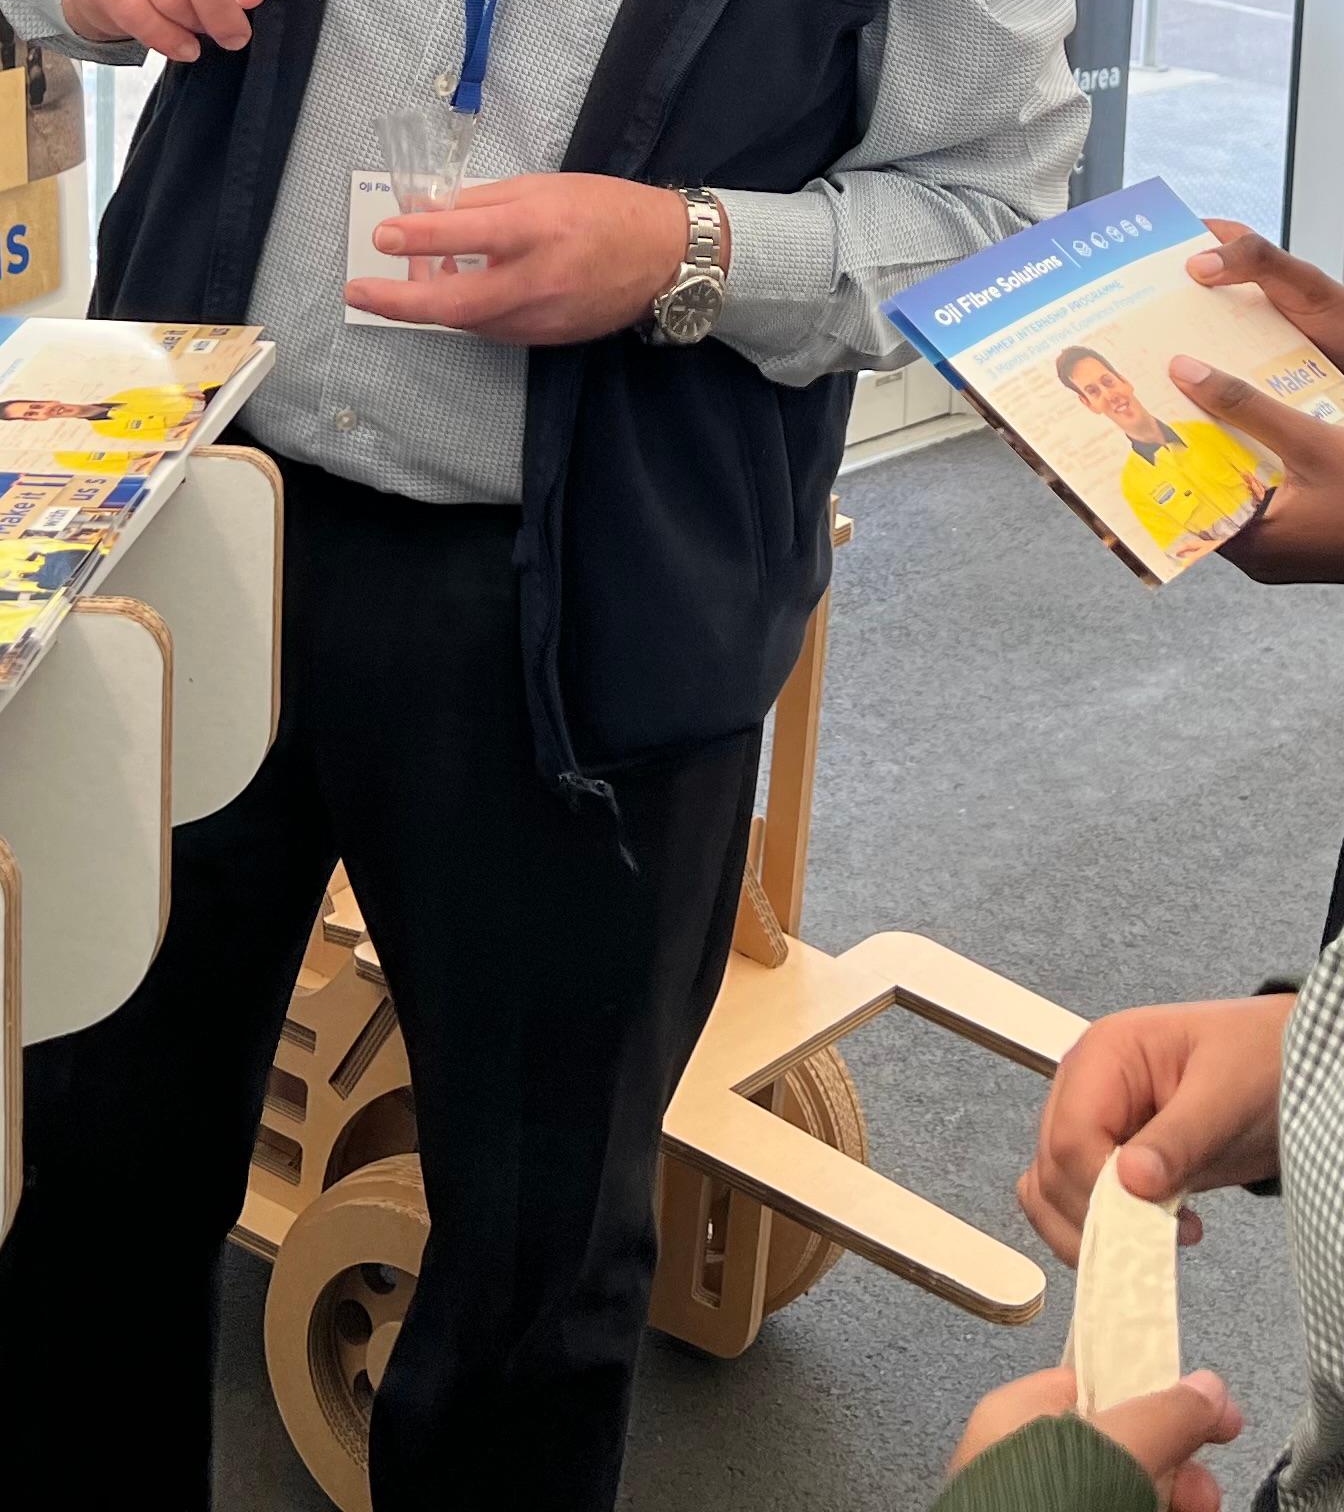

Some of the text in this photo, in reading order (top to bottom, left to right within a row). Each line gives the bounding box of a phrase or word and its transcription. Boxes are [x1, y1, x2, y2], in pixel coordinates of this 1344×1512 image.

[934, 255, 1063, 327] Oji Fibre Solutions
[1266, 359, 1327, 398] Make it
